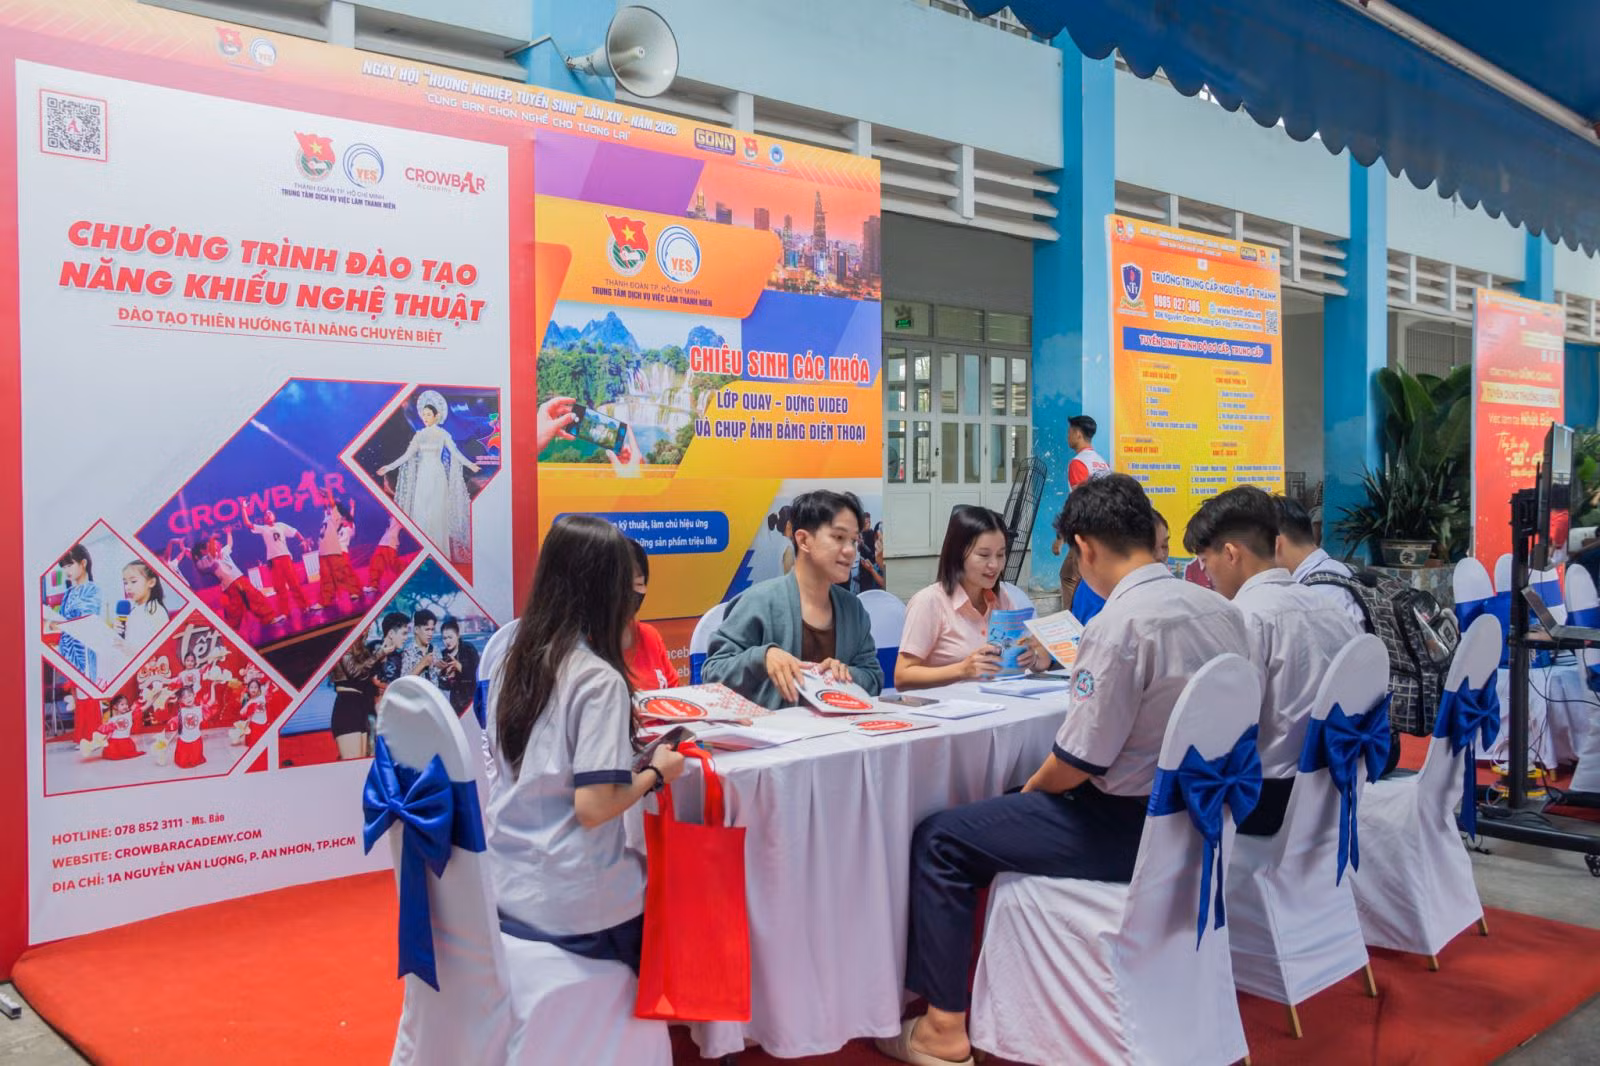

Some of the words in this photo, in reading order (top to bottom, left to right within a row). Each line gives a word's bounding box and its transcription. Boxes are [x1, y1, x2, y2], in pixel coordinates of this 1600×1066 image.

[552, 118, 573, 129] CHO
[606, 110, 623, 124] XIV
[356, 167, 378, 182] YES
[404, 167, 486, 195] CROWBAR
[281, 188, 301, 197] TRUNG
[67, 220, 229, 261] CHƯƠNG
[241, 237, 338, 273] TRÌNH
[345, 248, 412, 280] ĐÀO
[422, 259, 478, 290] TẠO
[671, 257, 693, 273] YES
[59, 256, 174, 296] NĂNG
[183, 269, 288, 306] KHIẾU
[295, 284, 386, 321] NGHỆ
[394, 292, 486, 328] THUẬT
[591, 286, 612, 297] TRUNG
[1182, 277, 1205, 290] TRUNG
[118, 305, 154, 322] ĐÀO
[156, 310, 188, 327] TẠO
[190, 312, 236, 328] THIÊN
[238, 316, 292, 332] HƯỚNG
[360, 326, 413, 341] CHUYÊN
[416, 327, 443, 345] BIỆT
[1162, 337, 1178, 347] SINH
[1231, 344, 1251, 356] TRUNG
[690, 344, 743, 375] CHIÊU
[748, 351, 789, 378] SINH
[793, 351, 825, 381] CÁC
[830, 353, 870, 383] KHÓA
[717, 388, 739, 409] LỚP
[742, 393, 772, 411] QUAY
[785, 394, 815, 416] DỰNG
[818, 397, 848, 413] VIDEO
[695, 417, 711, 437] VÀ
[715, 420, 747, 442] CHỤP
[750, 416, 773, 439] ẢNH
[776, 418, 806, 440] BẰNG
[809, 421, 834, 443] ĐIỆN
[837, 424, 866, 444] THOẠI
[618, 520, 628, 531] kỹ
[705, 536, 718, 545] like
[52, 827, 112, 845] HOTLINE:
[114, 824, 136, 837] 078
[138, 821, 159, 833] 852
[161, 818, 183, 830] 3111
[191, 815, 207, 826] Ms.
[52, 851, 112, 869] WEBSITE:
[114, 829, 262, 859] CROWBARACADEMY.COM
[107, 873, 122, 883] 1A
[204, 853, 248, 869] LƯỢNG,
[249, 851, 259, 862] P.
[261, 849, 277, 860] AN
[279, 842, 316, 857] NHƠN,
[316, 836, 356, 850] TP.HCM
